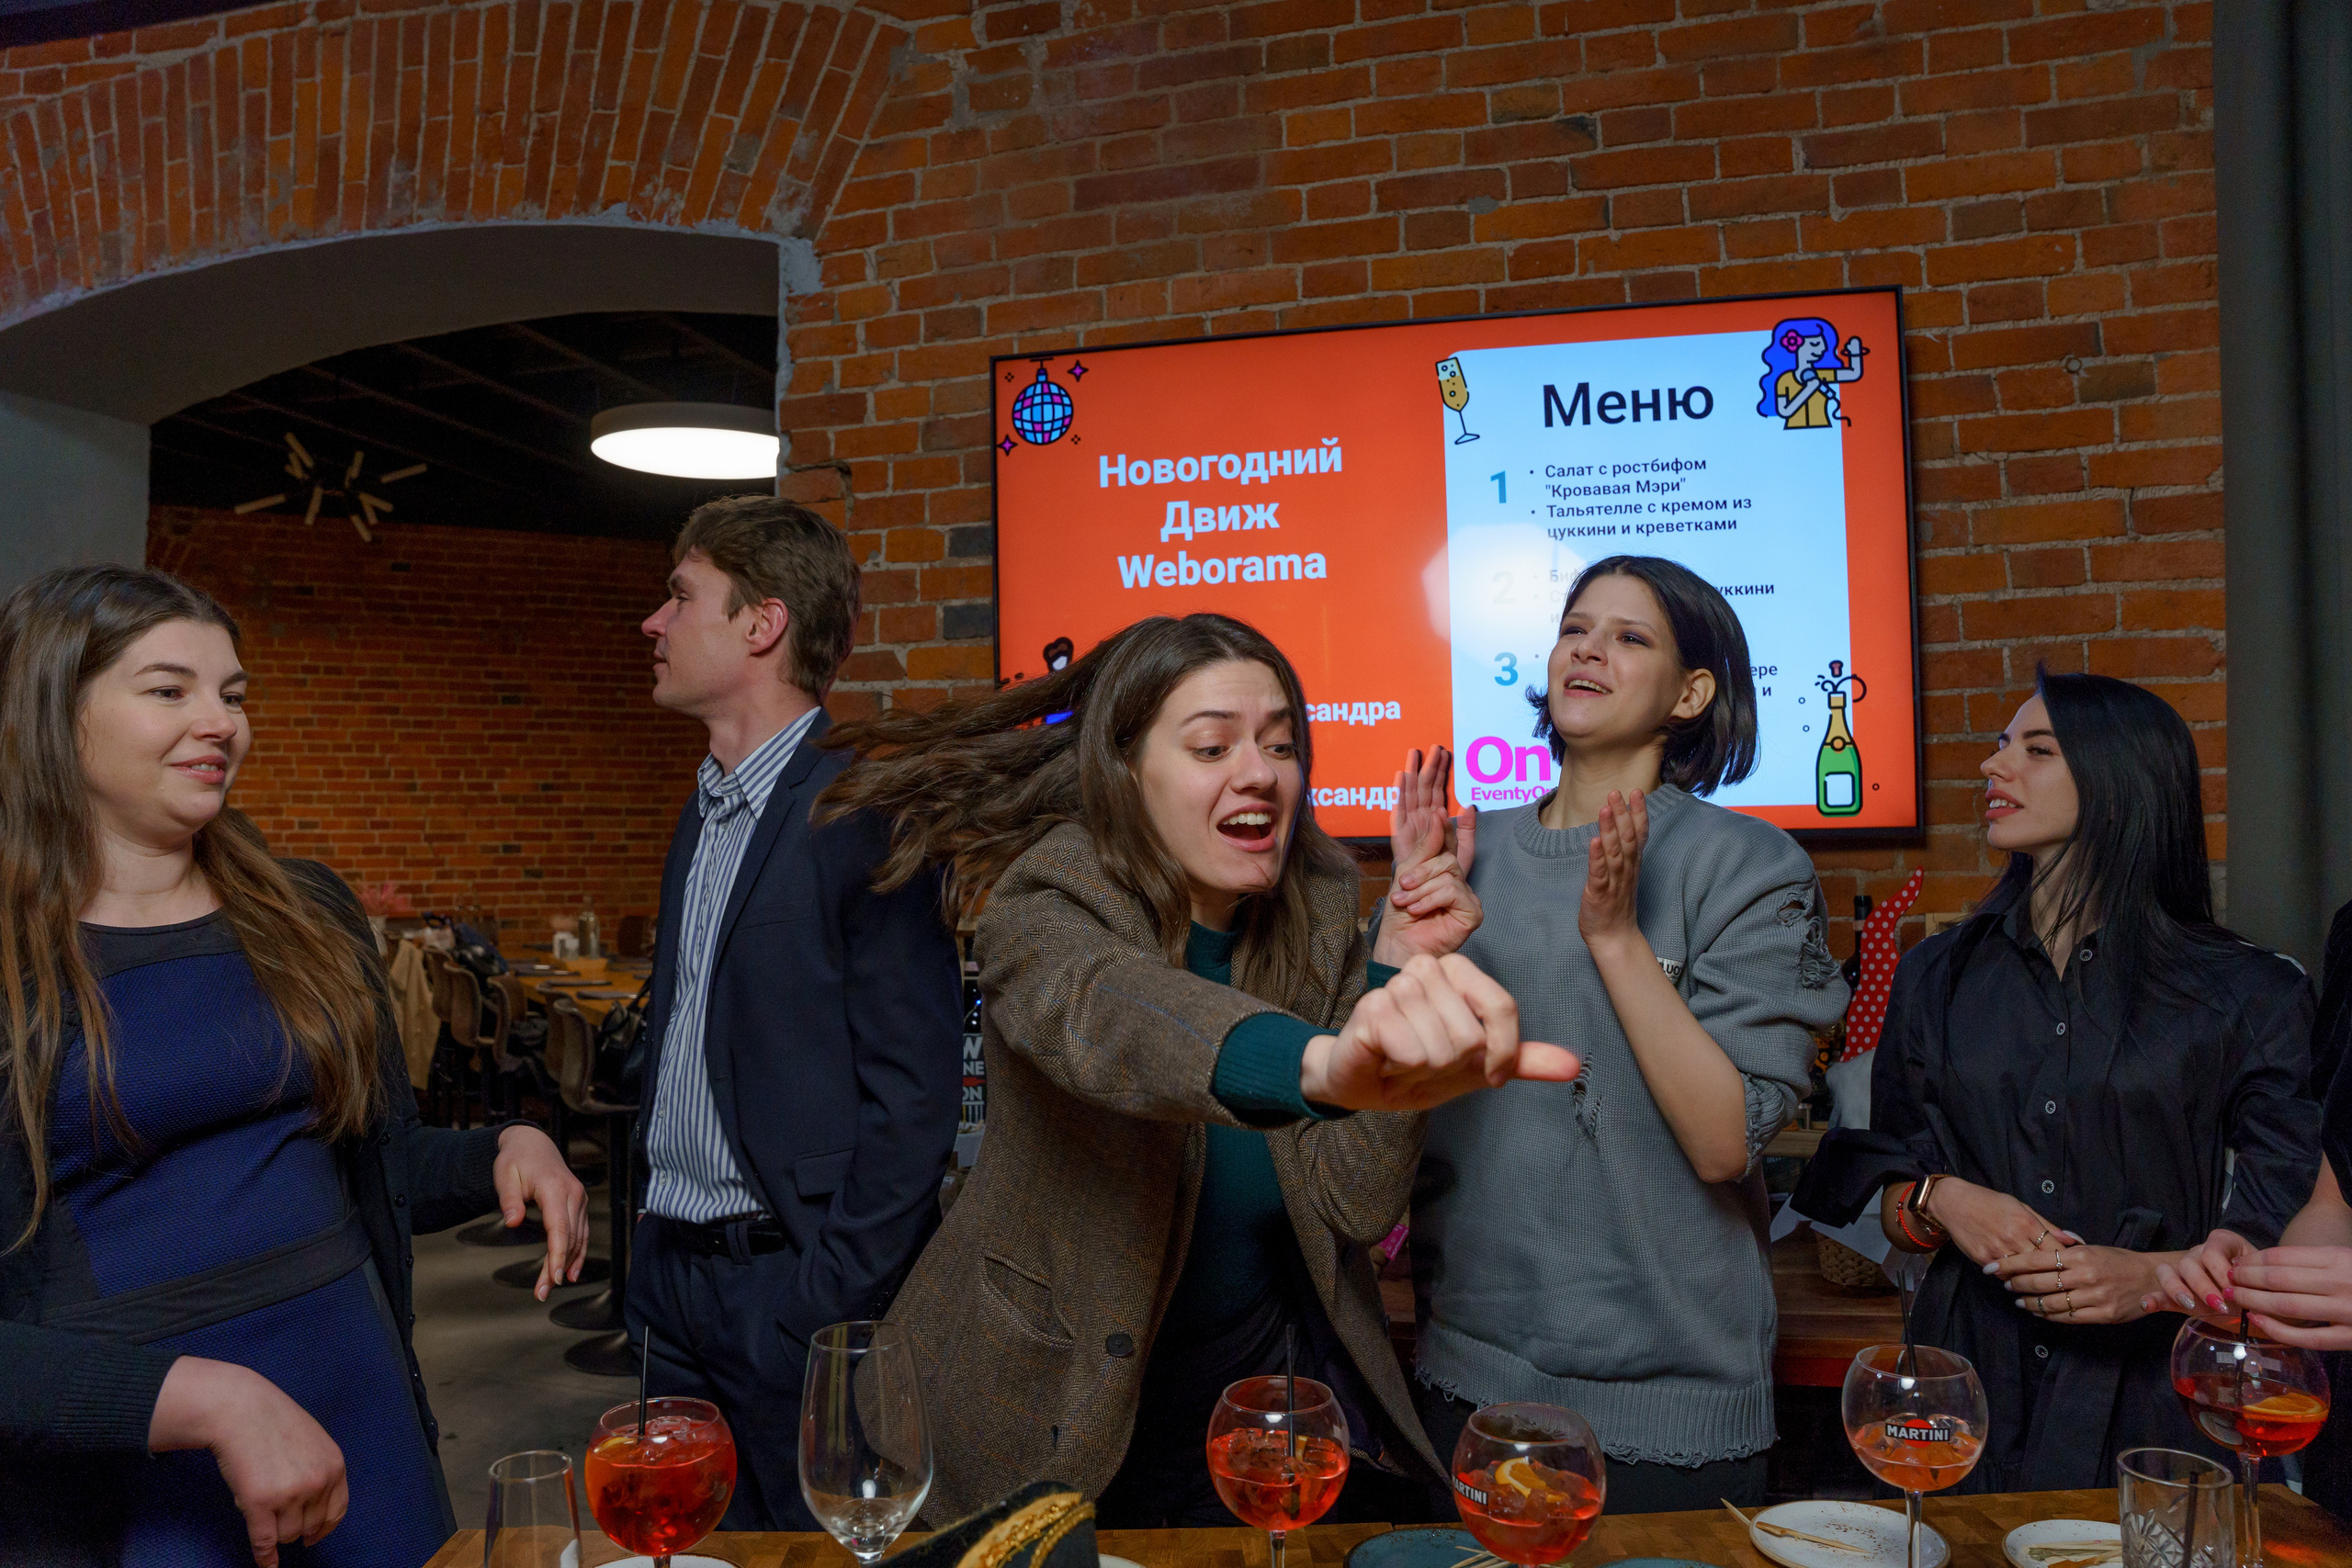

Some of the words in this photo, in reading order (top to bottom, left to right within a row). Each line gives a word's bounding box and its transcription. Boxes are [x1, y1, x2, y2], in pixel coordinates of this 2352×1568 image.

[1543, 382, 1714, 428] Меню
[1098, 436, 1342, 488] Новогодний
[1544, 464, 1594, 479] Салат
[1599, 464, 1608, 476] с
[1612, 457, 1707, 478] ростбифом
[1489, 470, 1508, 504] 1
[1544, 481, 1632, 501] "Кровавая
[1635, 478, 1686, 496] Мэри"
[1159, 500, 1281, 543] Движ
[1546, 502, 1643, 518] Тальятелле
[1647, 502, 1657, 513] с
[1661, 499, 1728, 515] кремом
[1733, 498, 1752, 510] из
[1547, 524, 1617, 541] цуккини
[1622, 524, 1631, 535] и
[1635, 519, 1737, 537] креветками
[1117, 550, 1328, 589] Weborama
[1494, 651, 1519, 687] 3
[1465, 736, 1552, 784] On
[1886, 1424, 1949, 1441] MARTINI
